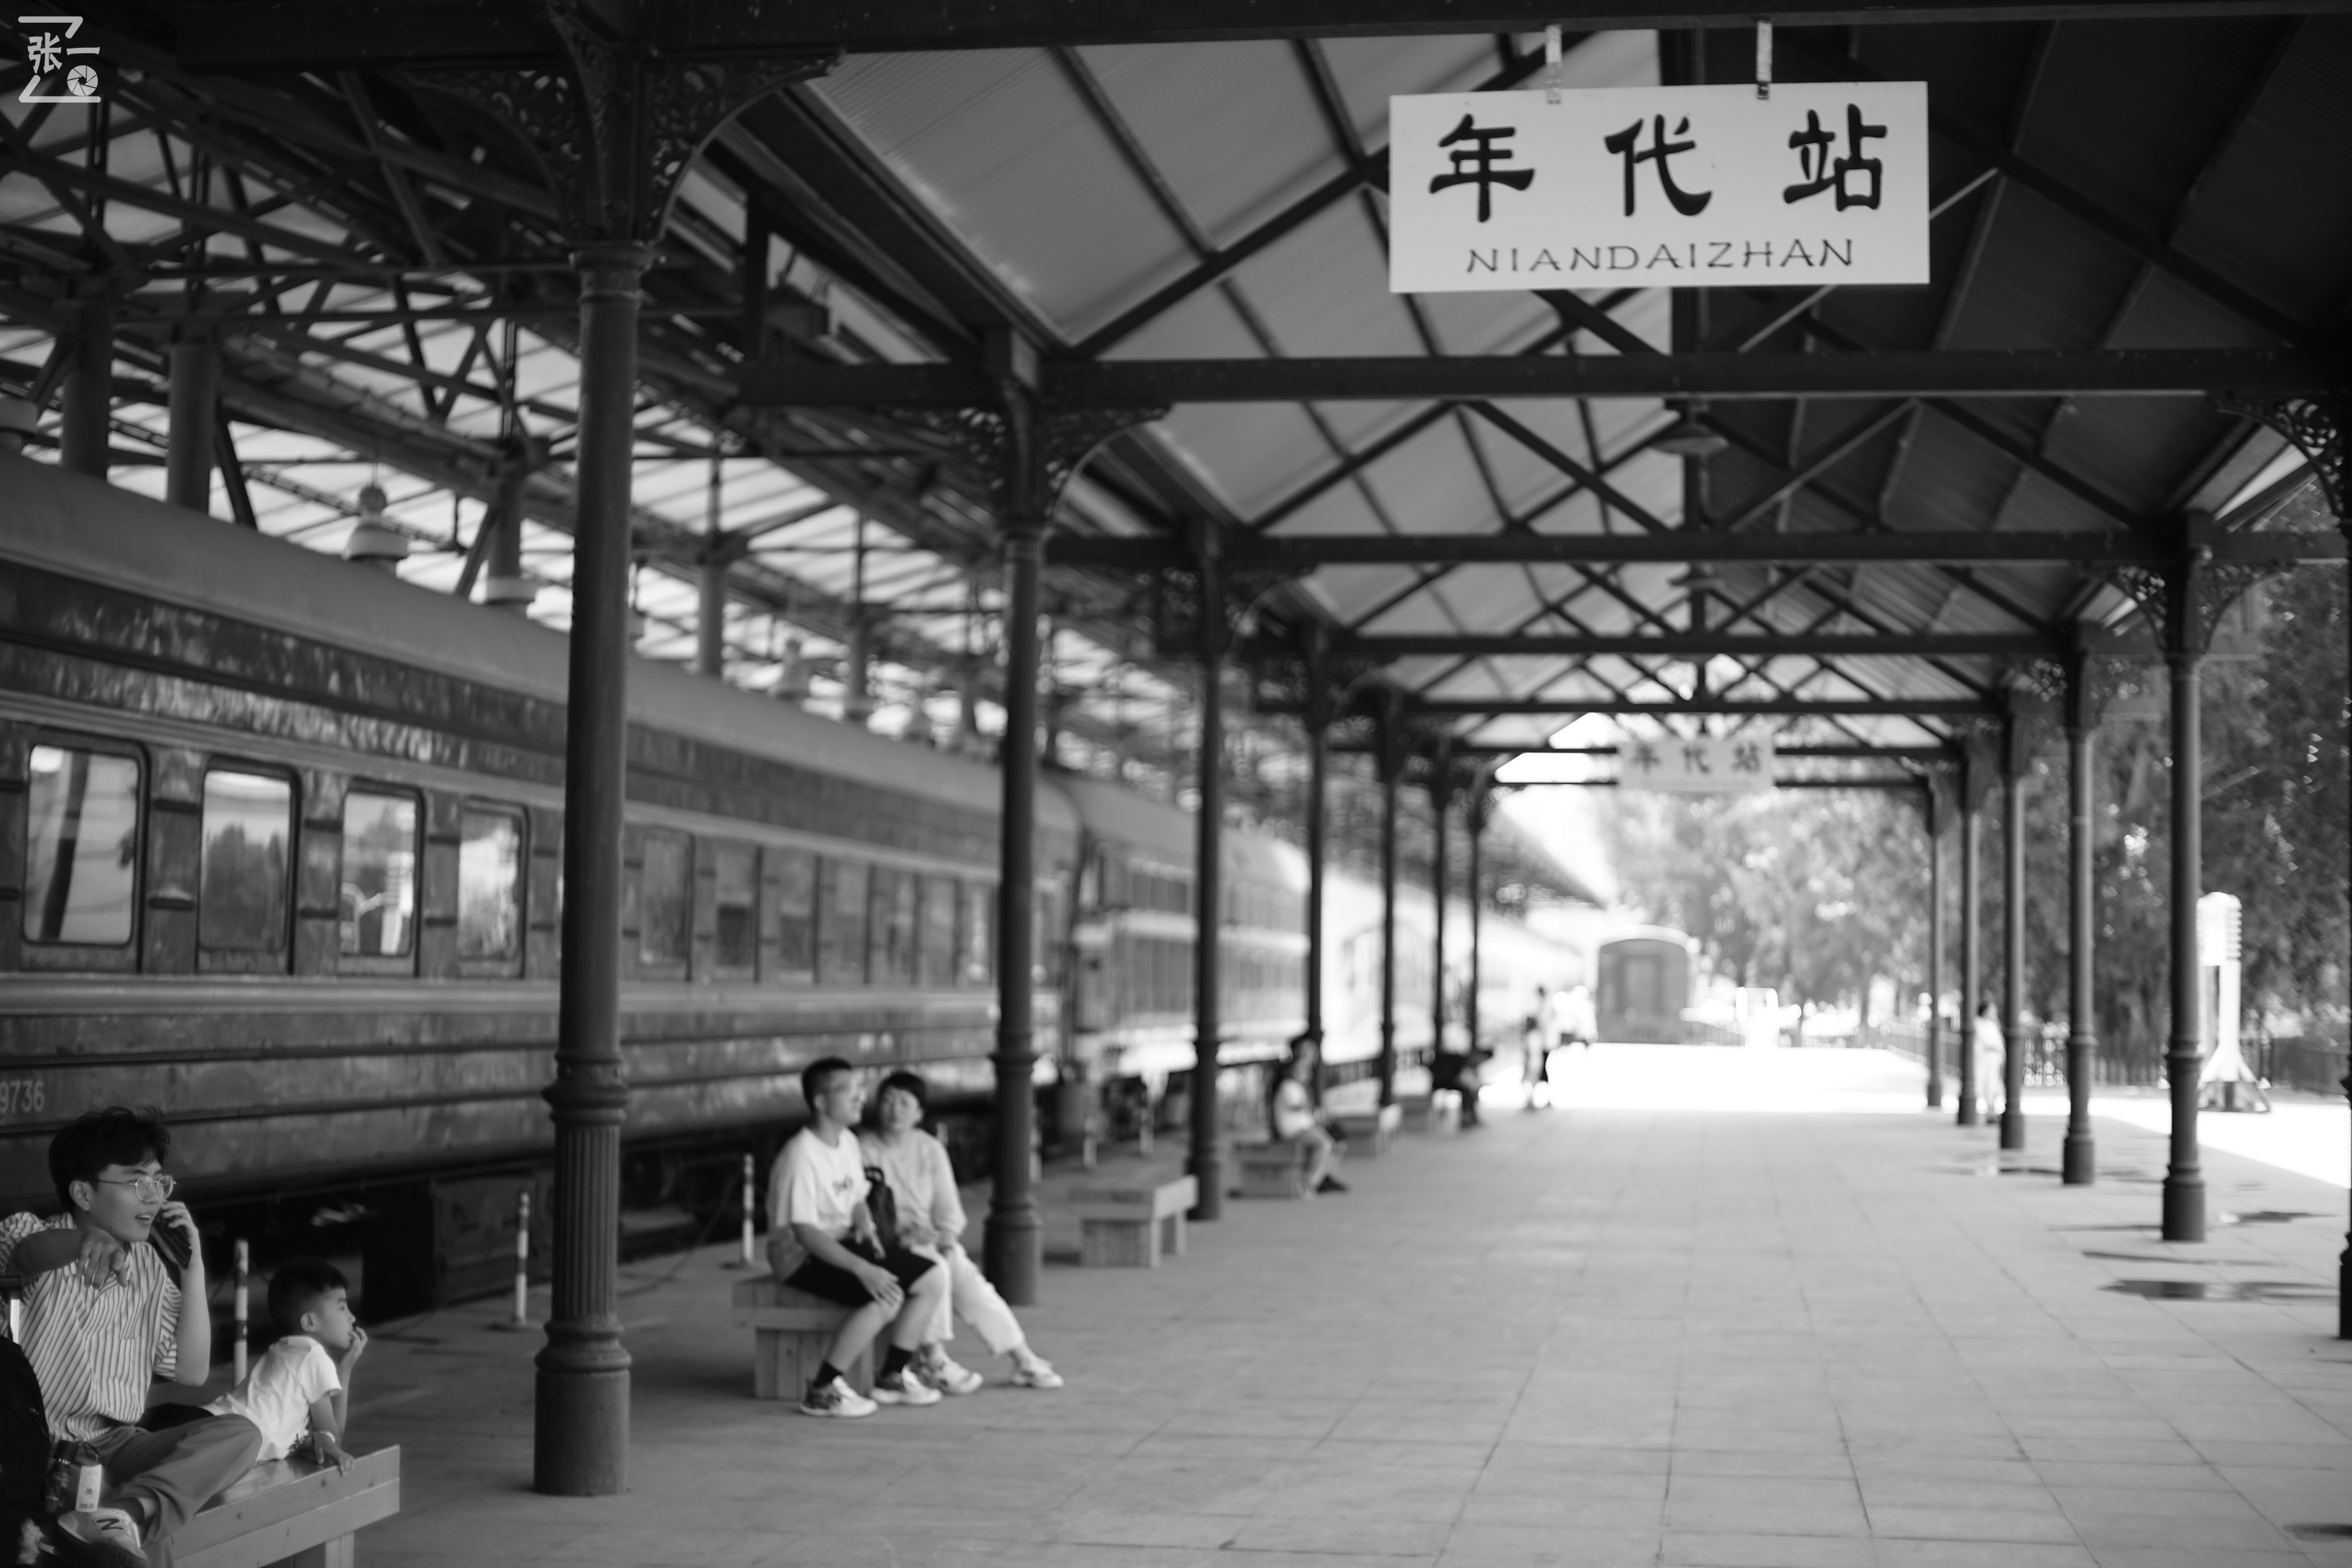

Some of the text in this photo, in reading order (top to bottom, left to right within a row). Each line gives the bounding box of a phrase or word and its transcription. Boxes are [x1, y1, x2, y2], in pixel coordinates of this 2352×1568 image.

[1428, 103, 1888, 223] 年代站
[1465, 238, 1853, 273] NIANDAIZHAN
